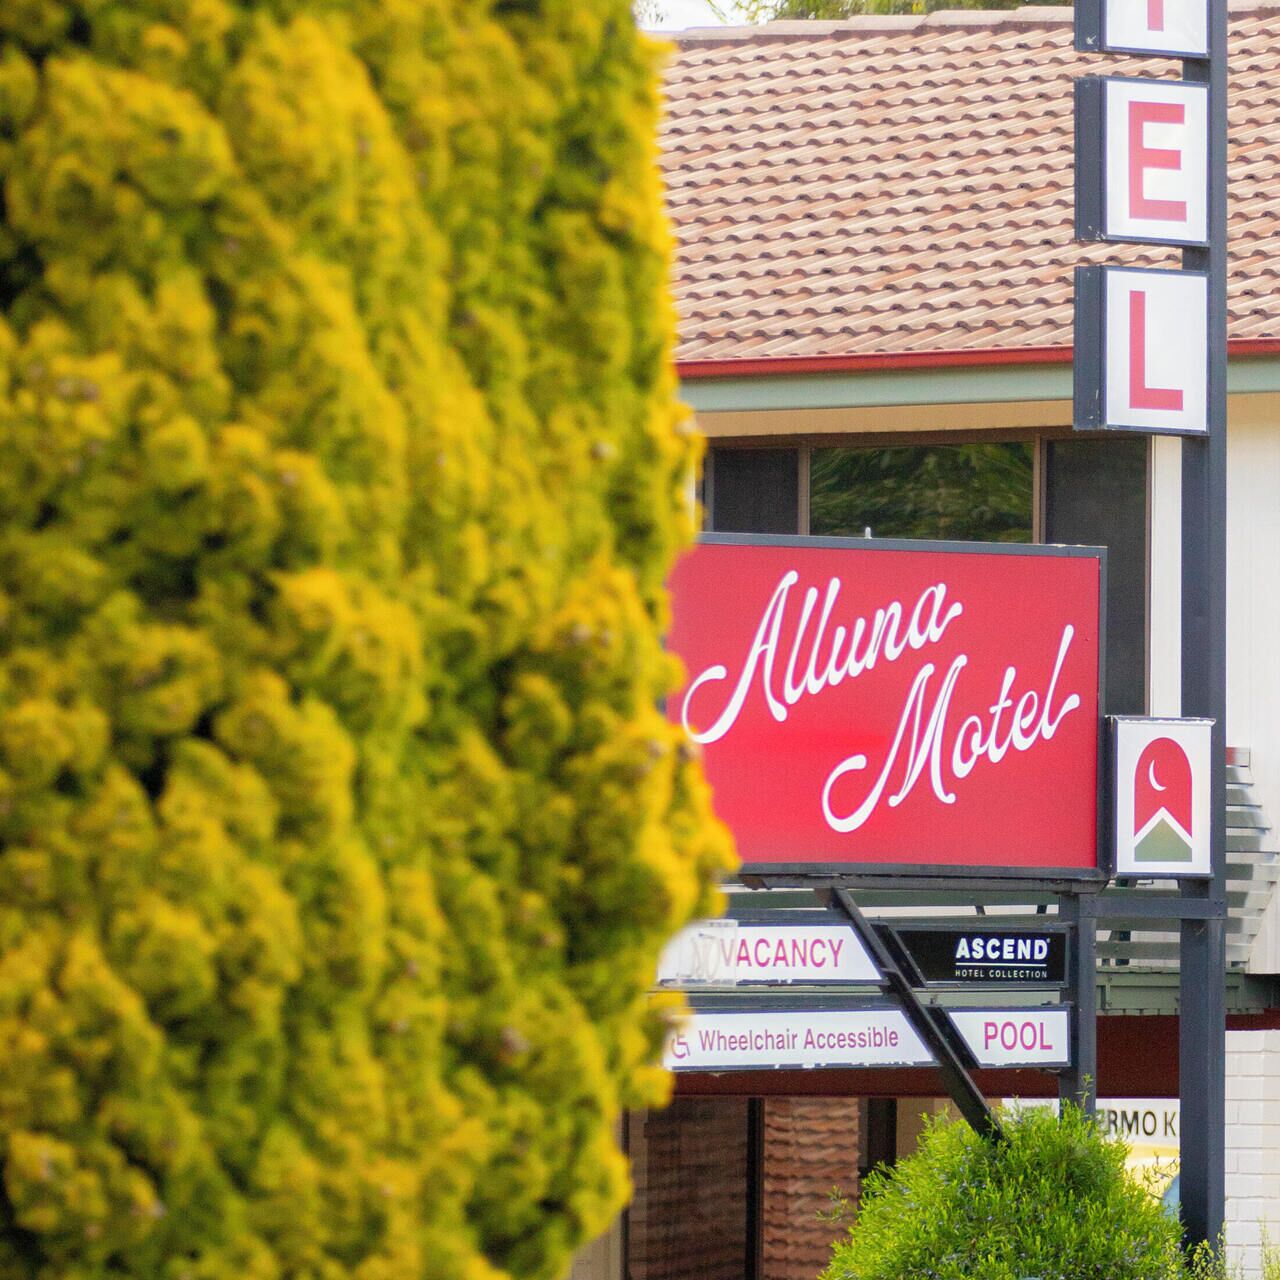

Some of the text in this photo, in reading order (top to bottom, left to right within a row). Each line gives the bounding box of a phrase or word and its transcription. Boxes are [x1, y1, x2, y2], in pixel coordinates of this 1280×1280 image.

[682, 570, 963, 744] Alluna
[821, 624, 1081, 833] Motel
[720, 938, 844, 968] VACANCY
[955, 937, 1048, 960] ASCEND
[955, 969, 1048, 978] HOTEL COLLECTION
[699, 1026, 899, 1052] Wheelchair Accessible
[983, 1021, 1053, 1051] POOL
